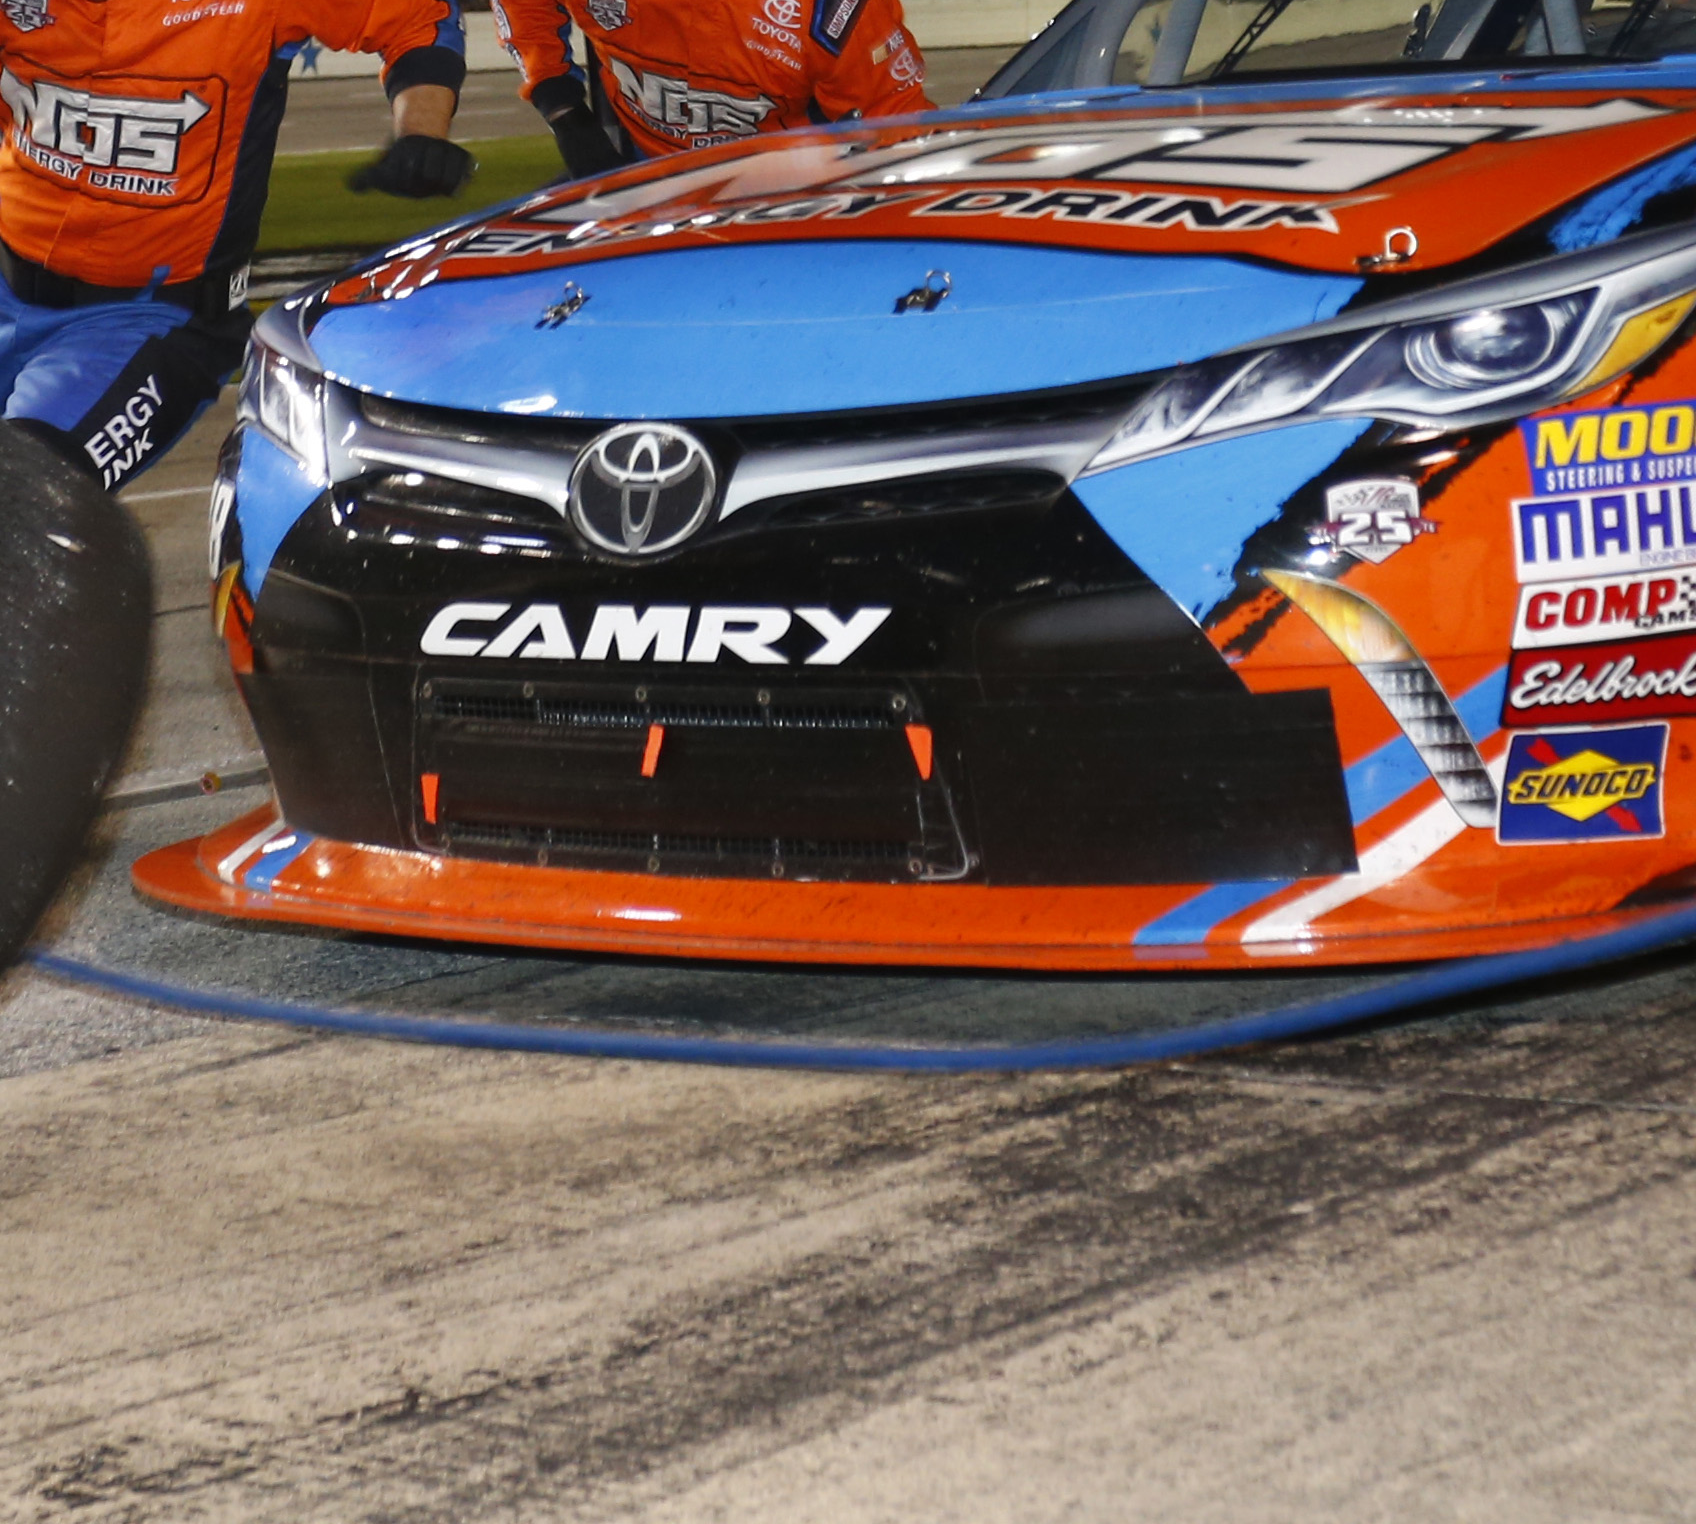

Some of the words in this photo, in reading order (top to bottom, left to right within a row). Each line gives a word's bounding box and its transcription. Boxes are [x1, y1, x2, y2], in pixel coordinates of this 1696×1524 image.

[752, 16, 802, 54] TOYOTA
[0, 66, 211, 173] NOS
[610, 56, 779, 137] NOS
[12, 129, 82, 180] ENERGY
[88, 170, 179, 196] DRINK
[906, 184, 1392, 236] DRINK
[84, 374, 164, 469] ERGY
[104, 428, 154, 491] INK
[1546, 461, 1626, 493] STEERING
[1630, 461, 1642, 483] &
[1337, 511, 1413, 546] 25
[1639, 548, 1685, 567] ENGINE
[1525, 578, 1678, 632] COMP
[419, 602, 893, 666] CAMRY
[1514, 768, 1652, 801] SUNOCO
